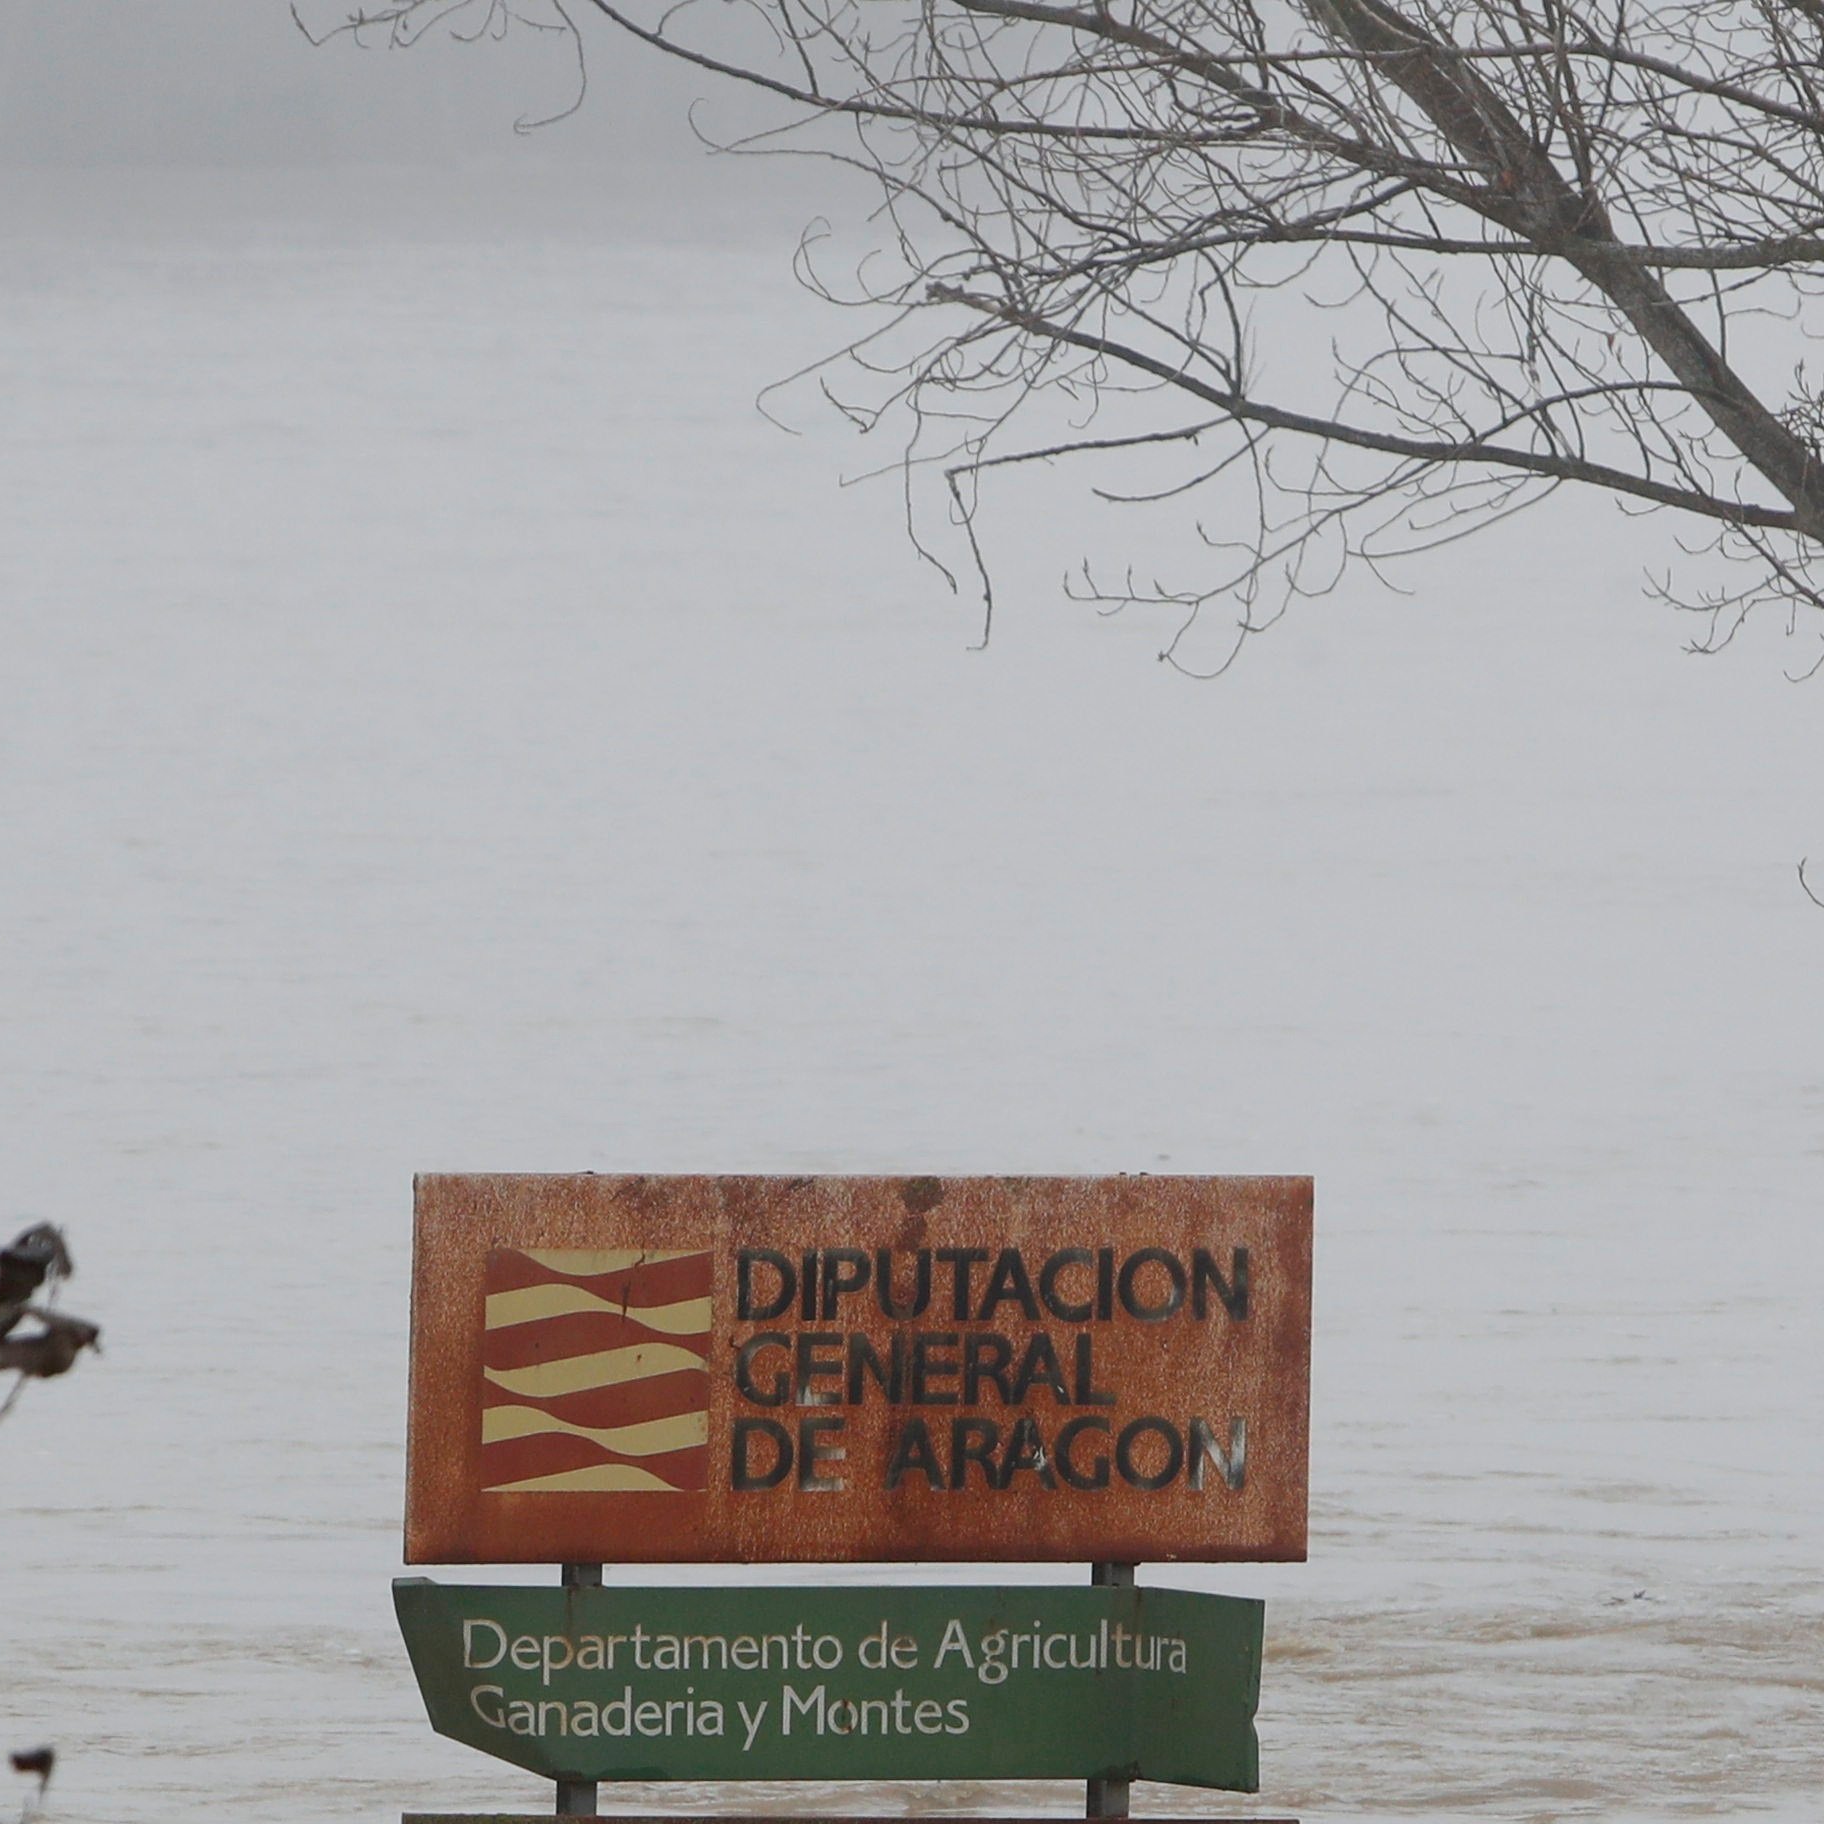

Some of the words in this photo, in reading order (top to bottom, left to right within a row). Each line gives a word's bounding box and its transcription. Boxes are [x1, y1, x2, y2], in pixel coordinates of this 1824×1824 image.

[736, 1246, 1249, 1323] DIPUTACION
[735, 1332, 1114, 1407] GENERAL
[731, 1416, 845, 1491] DE
[882, 1415, 1248, 1492] ARAGON
[463, 1619, 844, 1685] Departamento
[858, 1619, 919, 1670] de
[934, 1618, 1188, 1685] Agricultura
[470, 1684, 725, 1737] Ganaderia
[738, 1698, 768, 1751] y
[782, 1685, 970, 1735] Montes
